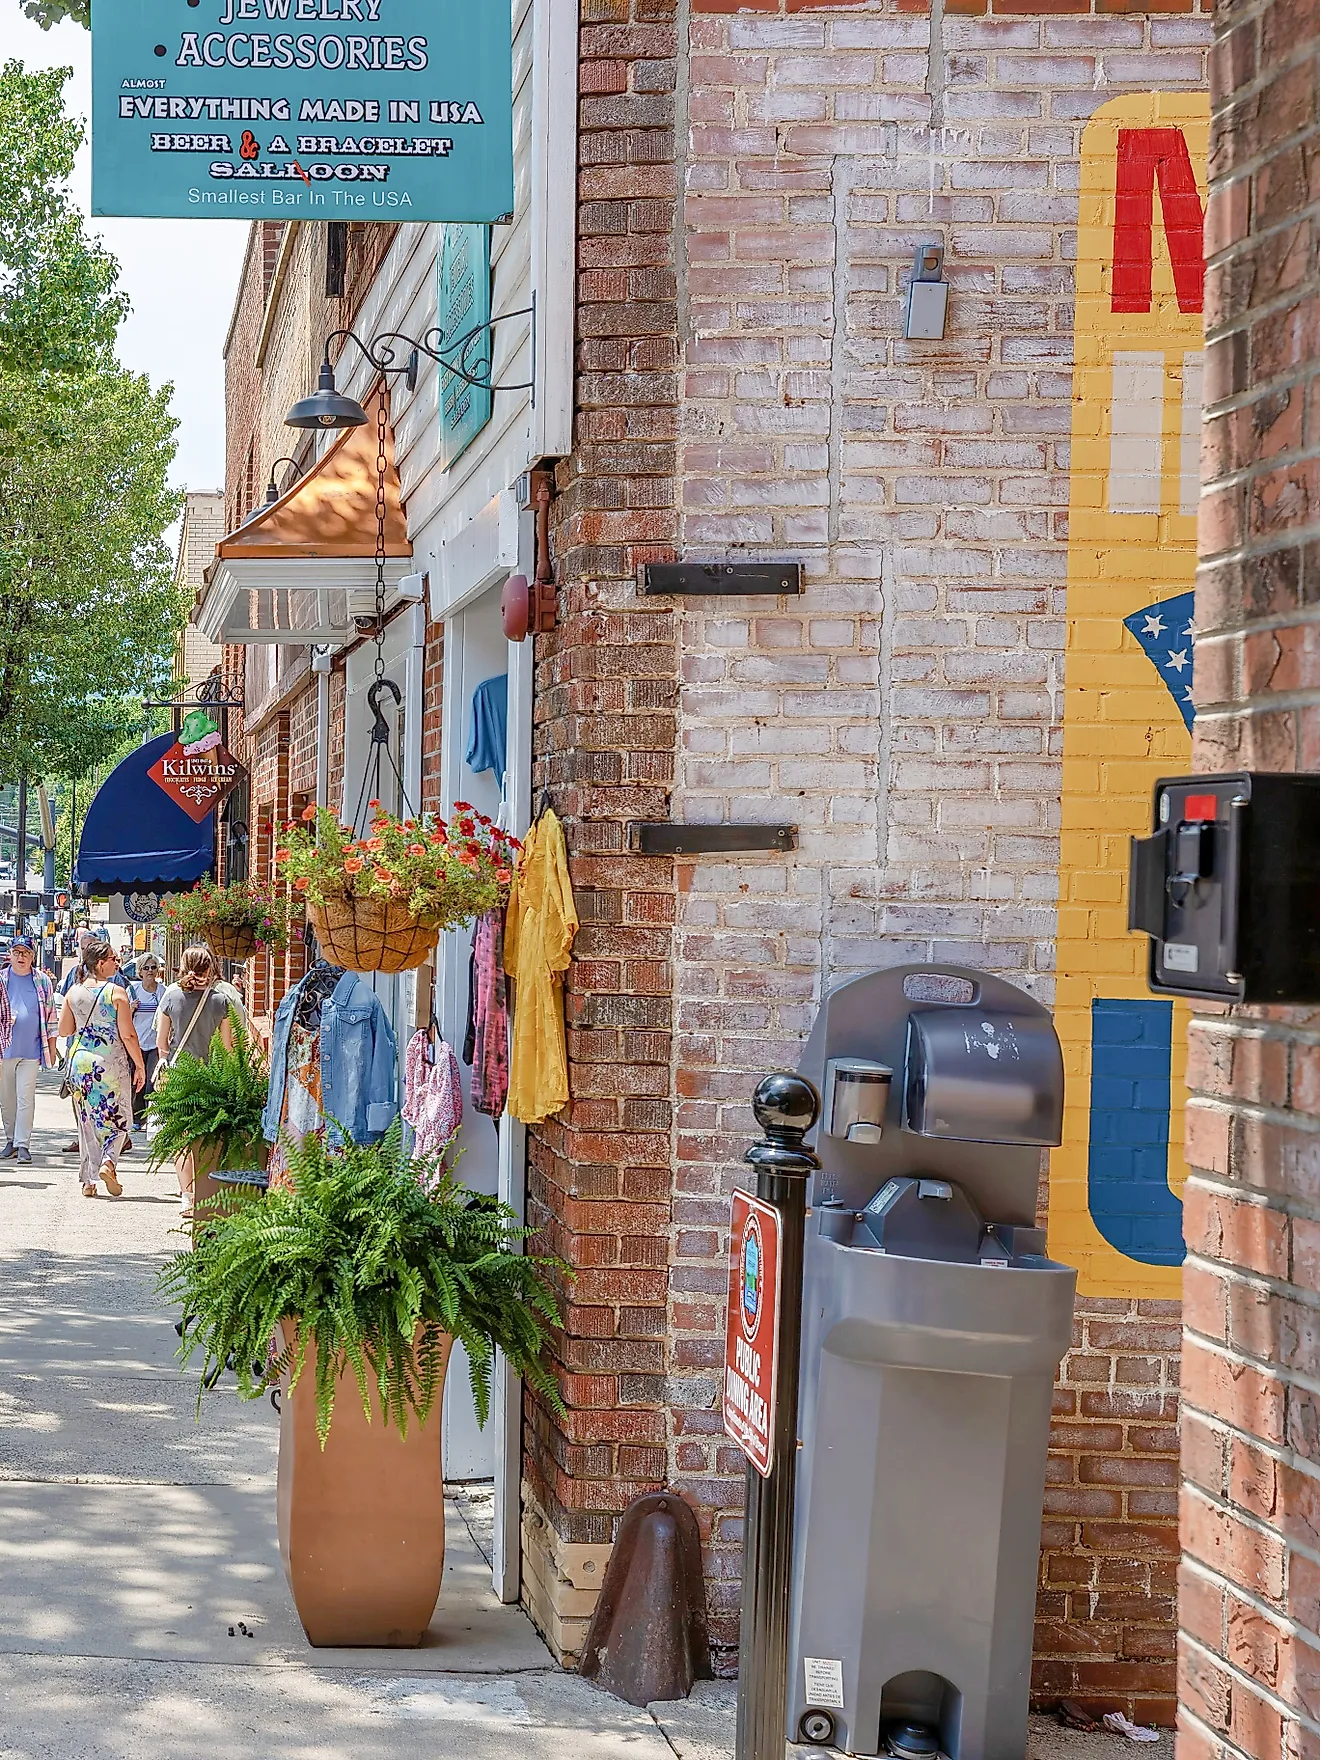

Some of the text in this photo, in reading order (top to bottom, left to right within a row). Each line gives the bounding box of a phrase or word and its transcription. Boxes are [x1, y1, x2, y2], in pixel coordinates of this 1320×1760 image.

[220, 0, 381, 24] JEWELRY
[176, 32, 430, 71] ACCESSORIES
[122, 78, 167, 90] ALMOST
[119, 95, 484, 124] EVERYTHING MADE IN USA
[151, 130, 453, 160] BEER & A BRACELET
[188, 188, 413, 208] Smallest Bar In The USA
[162, 759, 236, 776] Kilwins
[736, 1335, 761, 1388] PUBLIC
[726, 1365, 749, 1418] DINING
[749, 1388, 768, 1439] AREA
